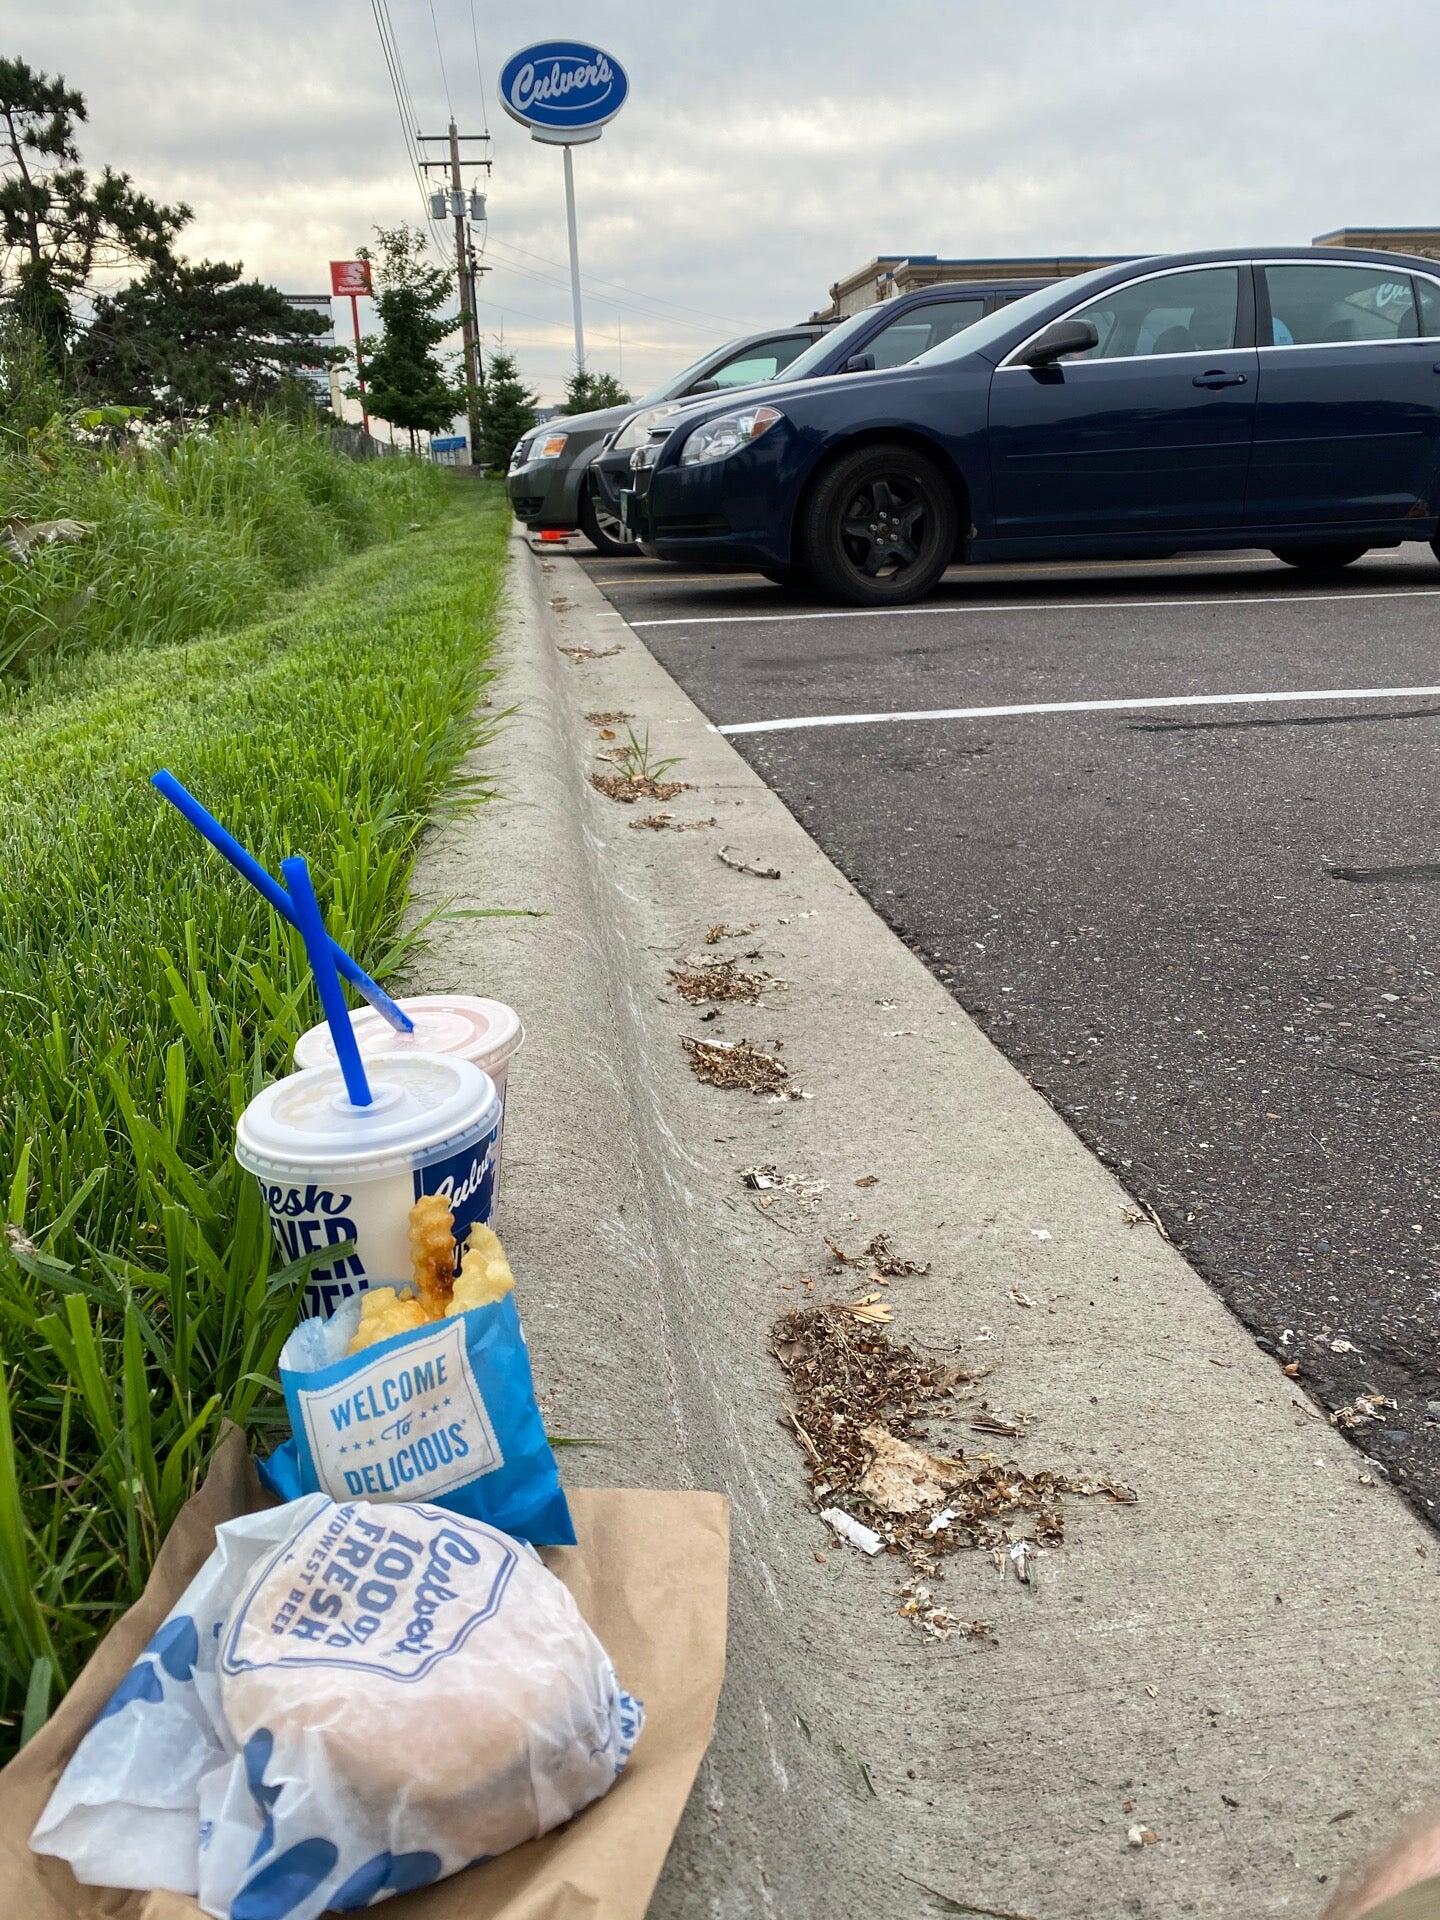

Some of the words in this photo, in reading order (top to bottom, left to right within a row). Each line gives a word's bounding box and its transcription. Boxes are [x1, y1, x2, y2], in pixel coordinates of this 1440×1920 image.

[511, 53, 613, 110] Culver's
[329, 1353, 449, 1432] WELCOME
[343, 1422, 469, 1496] DELICIOUS
[288, 1518, 387, 1641] FRESH
[300, 1504, 356, 1585] MIDWEST
[270, 1588, 306, 1635] BEEF
[325, 1530, 424, 1648] 100%
